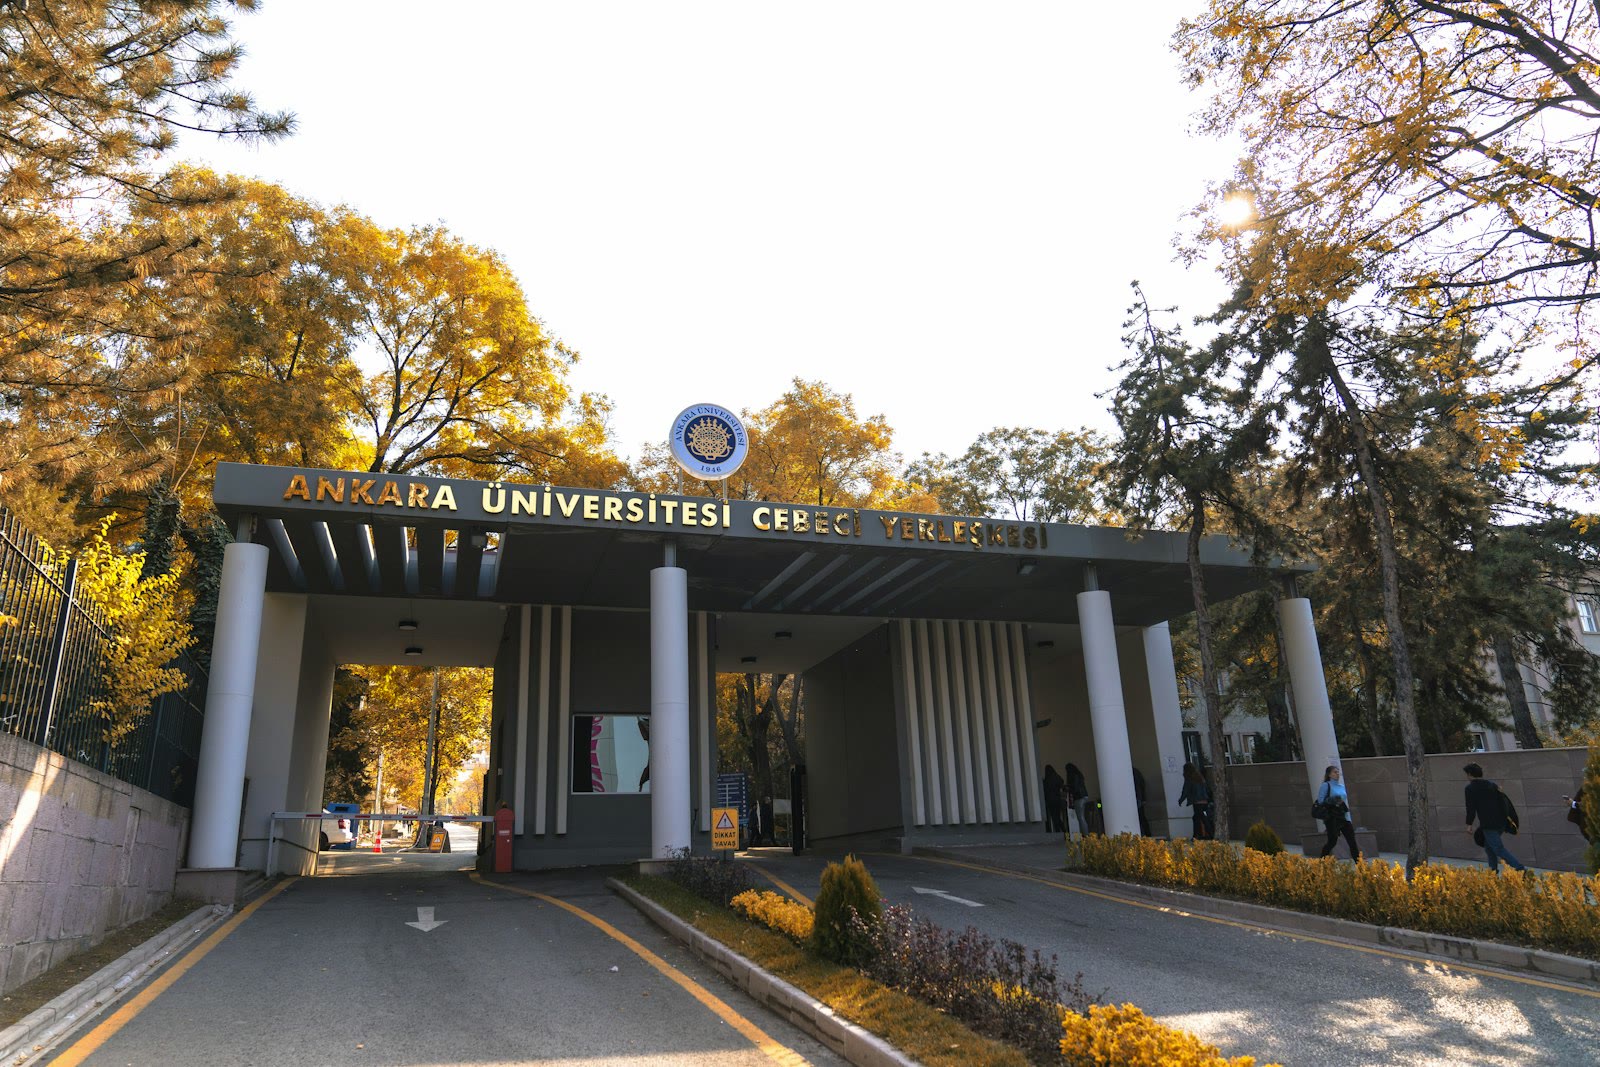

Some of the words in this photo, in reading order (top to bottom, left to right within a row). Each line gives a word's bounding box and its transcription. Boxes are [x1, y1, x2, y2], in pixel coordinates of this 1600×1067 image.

[675, 410, 697, 442] ANKARA
[700, 465, 722, 473] 1946
[283, 474, 458, 511] ANKARA
[482, 482, 731, 528] ÜNİVERSİTESİ
[752, 507, 862, 537] CEBECİ
[879, 515, 1048, 551] YERLEŞKESİ
